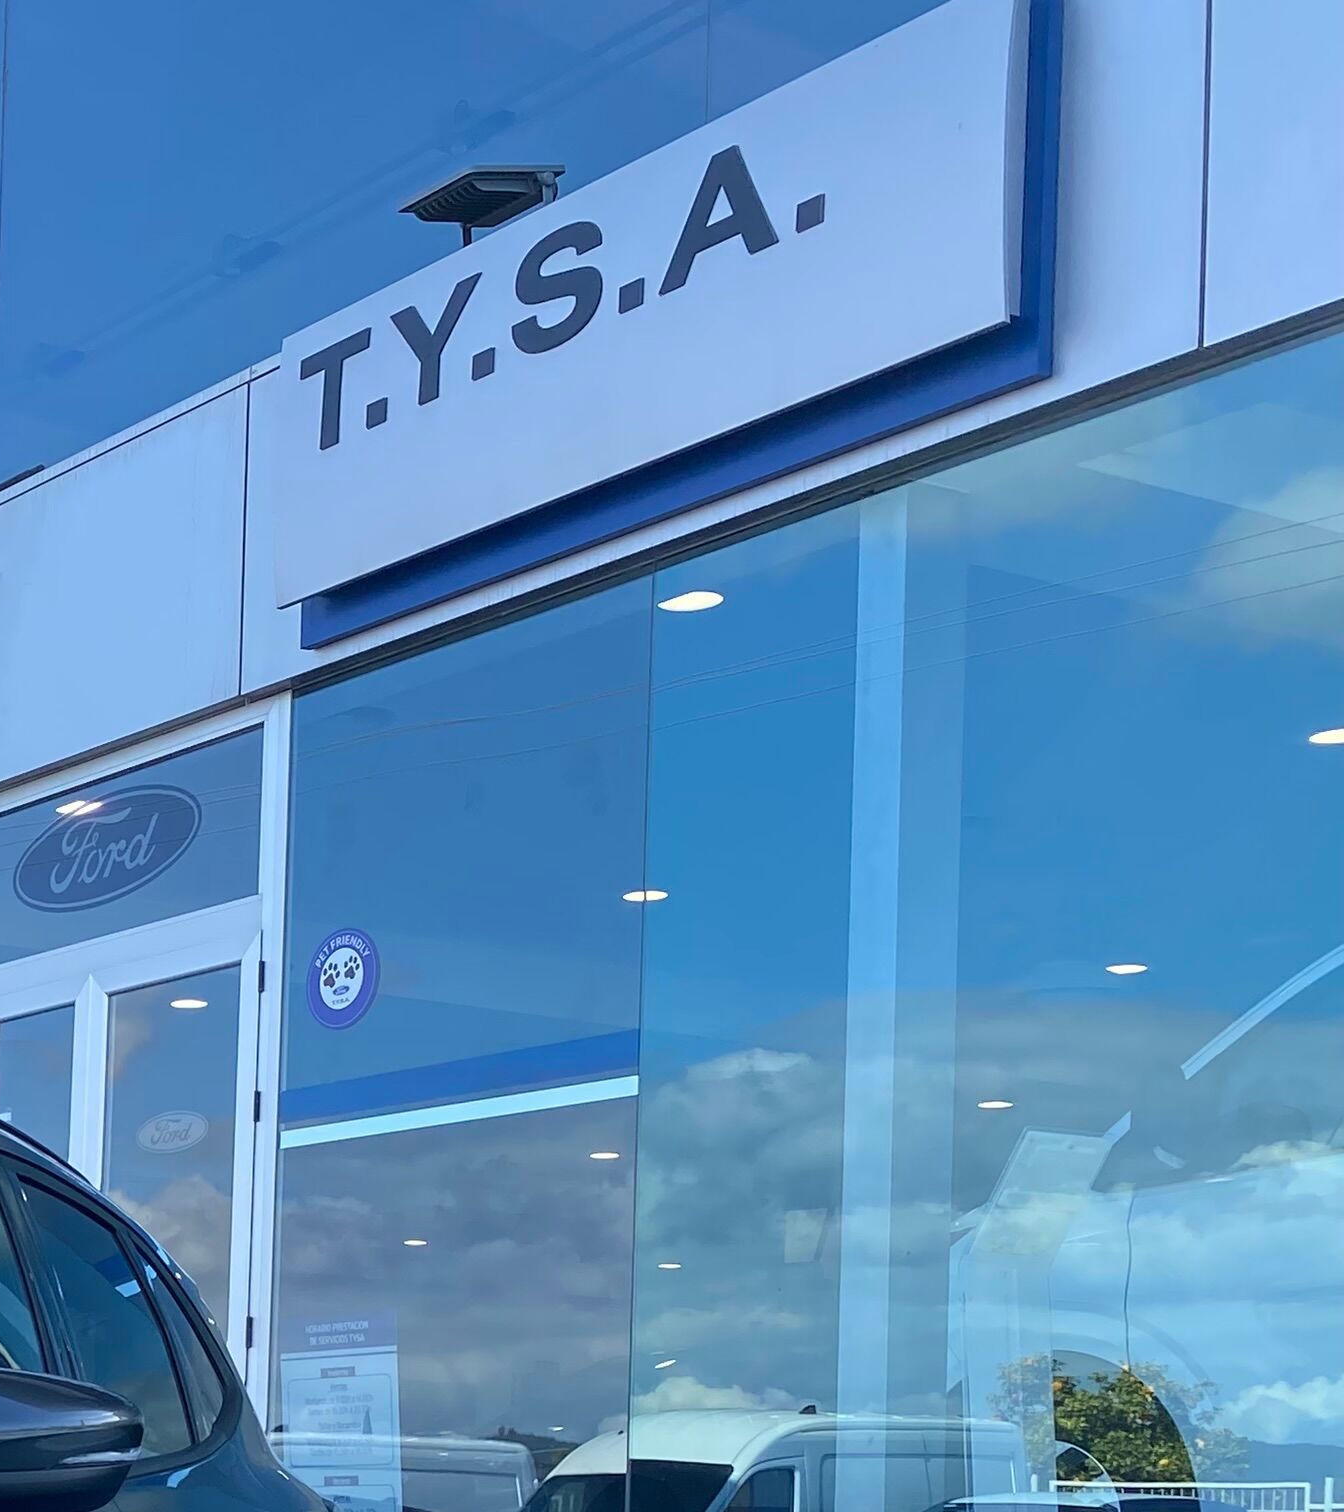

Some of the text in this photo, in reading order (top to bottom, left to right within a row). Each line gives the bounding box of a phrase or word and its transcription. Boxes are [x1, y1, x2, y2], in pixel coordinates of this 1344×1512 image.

[299, 144, 826, 452] T.Y.S.A.
[49, 806, 160, 895] Ford
[314, 934, 371, 968] PET FRIENDLY
[150, 1118, 193, 1145] Ford
